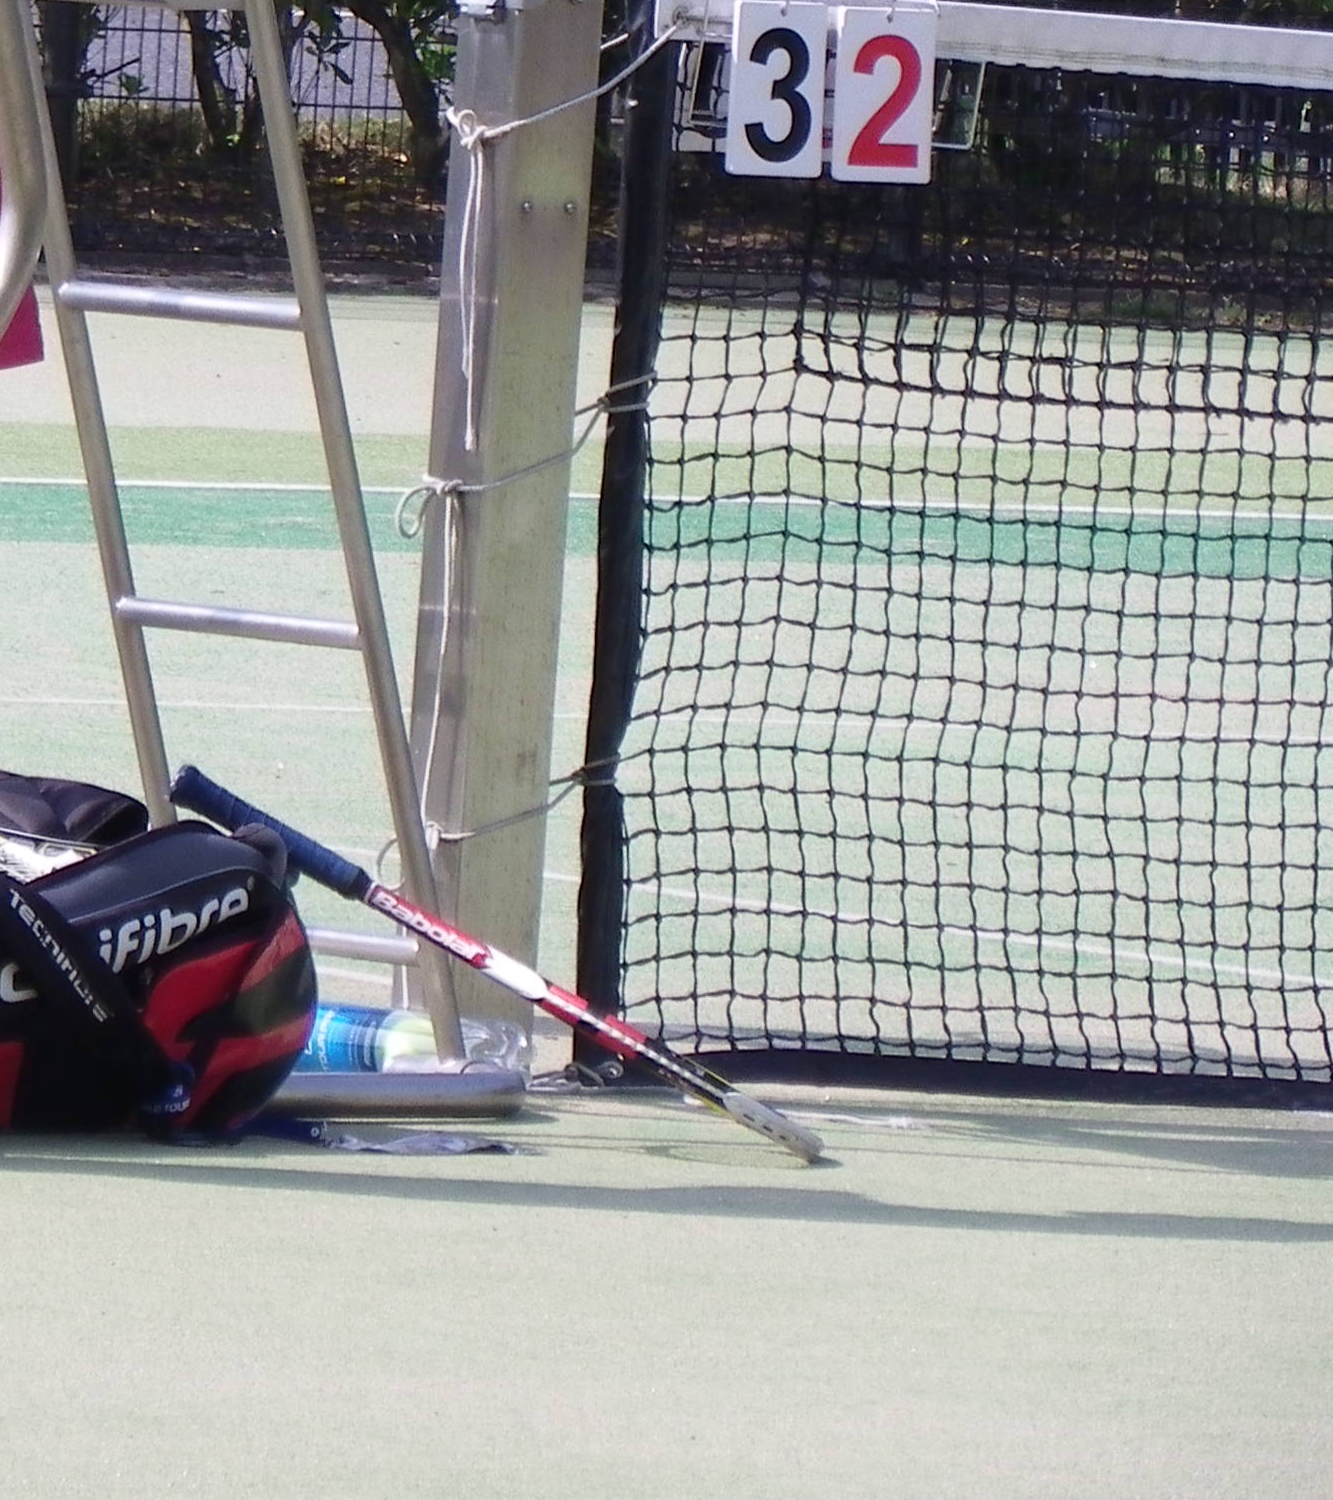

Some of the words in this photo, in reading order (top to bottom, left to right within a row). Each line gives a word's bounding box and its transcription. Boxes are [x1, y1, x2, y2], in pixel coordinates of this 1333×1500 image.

[743, 26, 813, 163] 3
[846, 33, 924, 169] 2
[370, 891, 488, 959] Babolat
